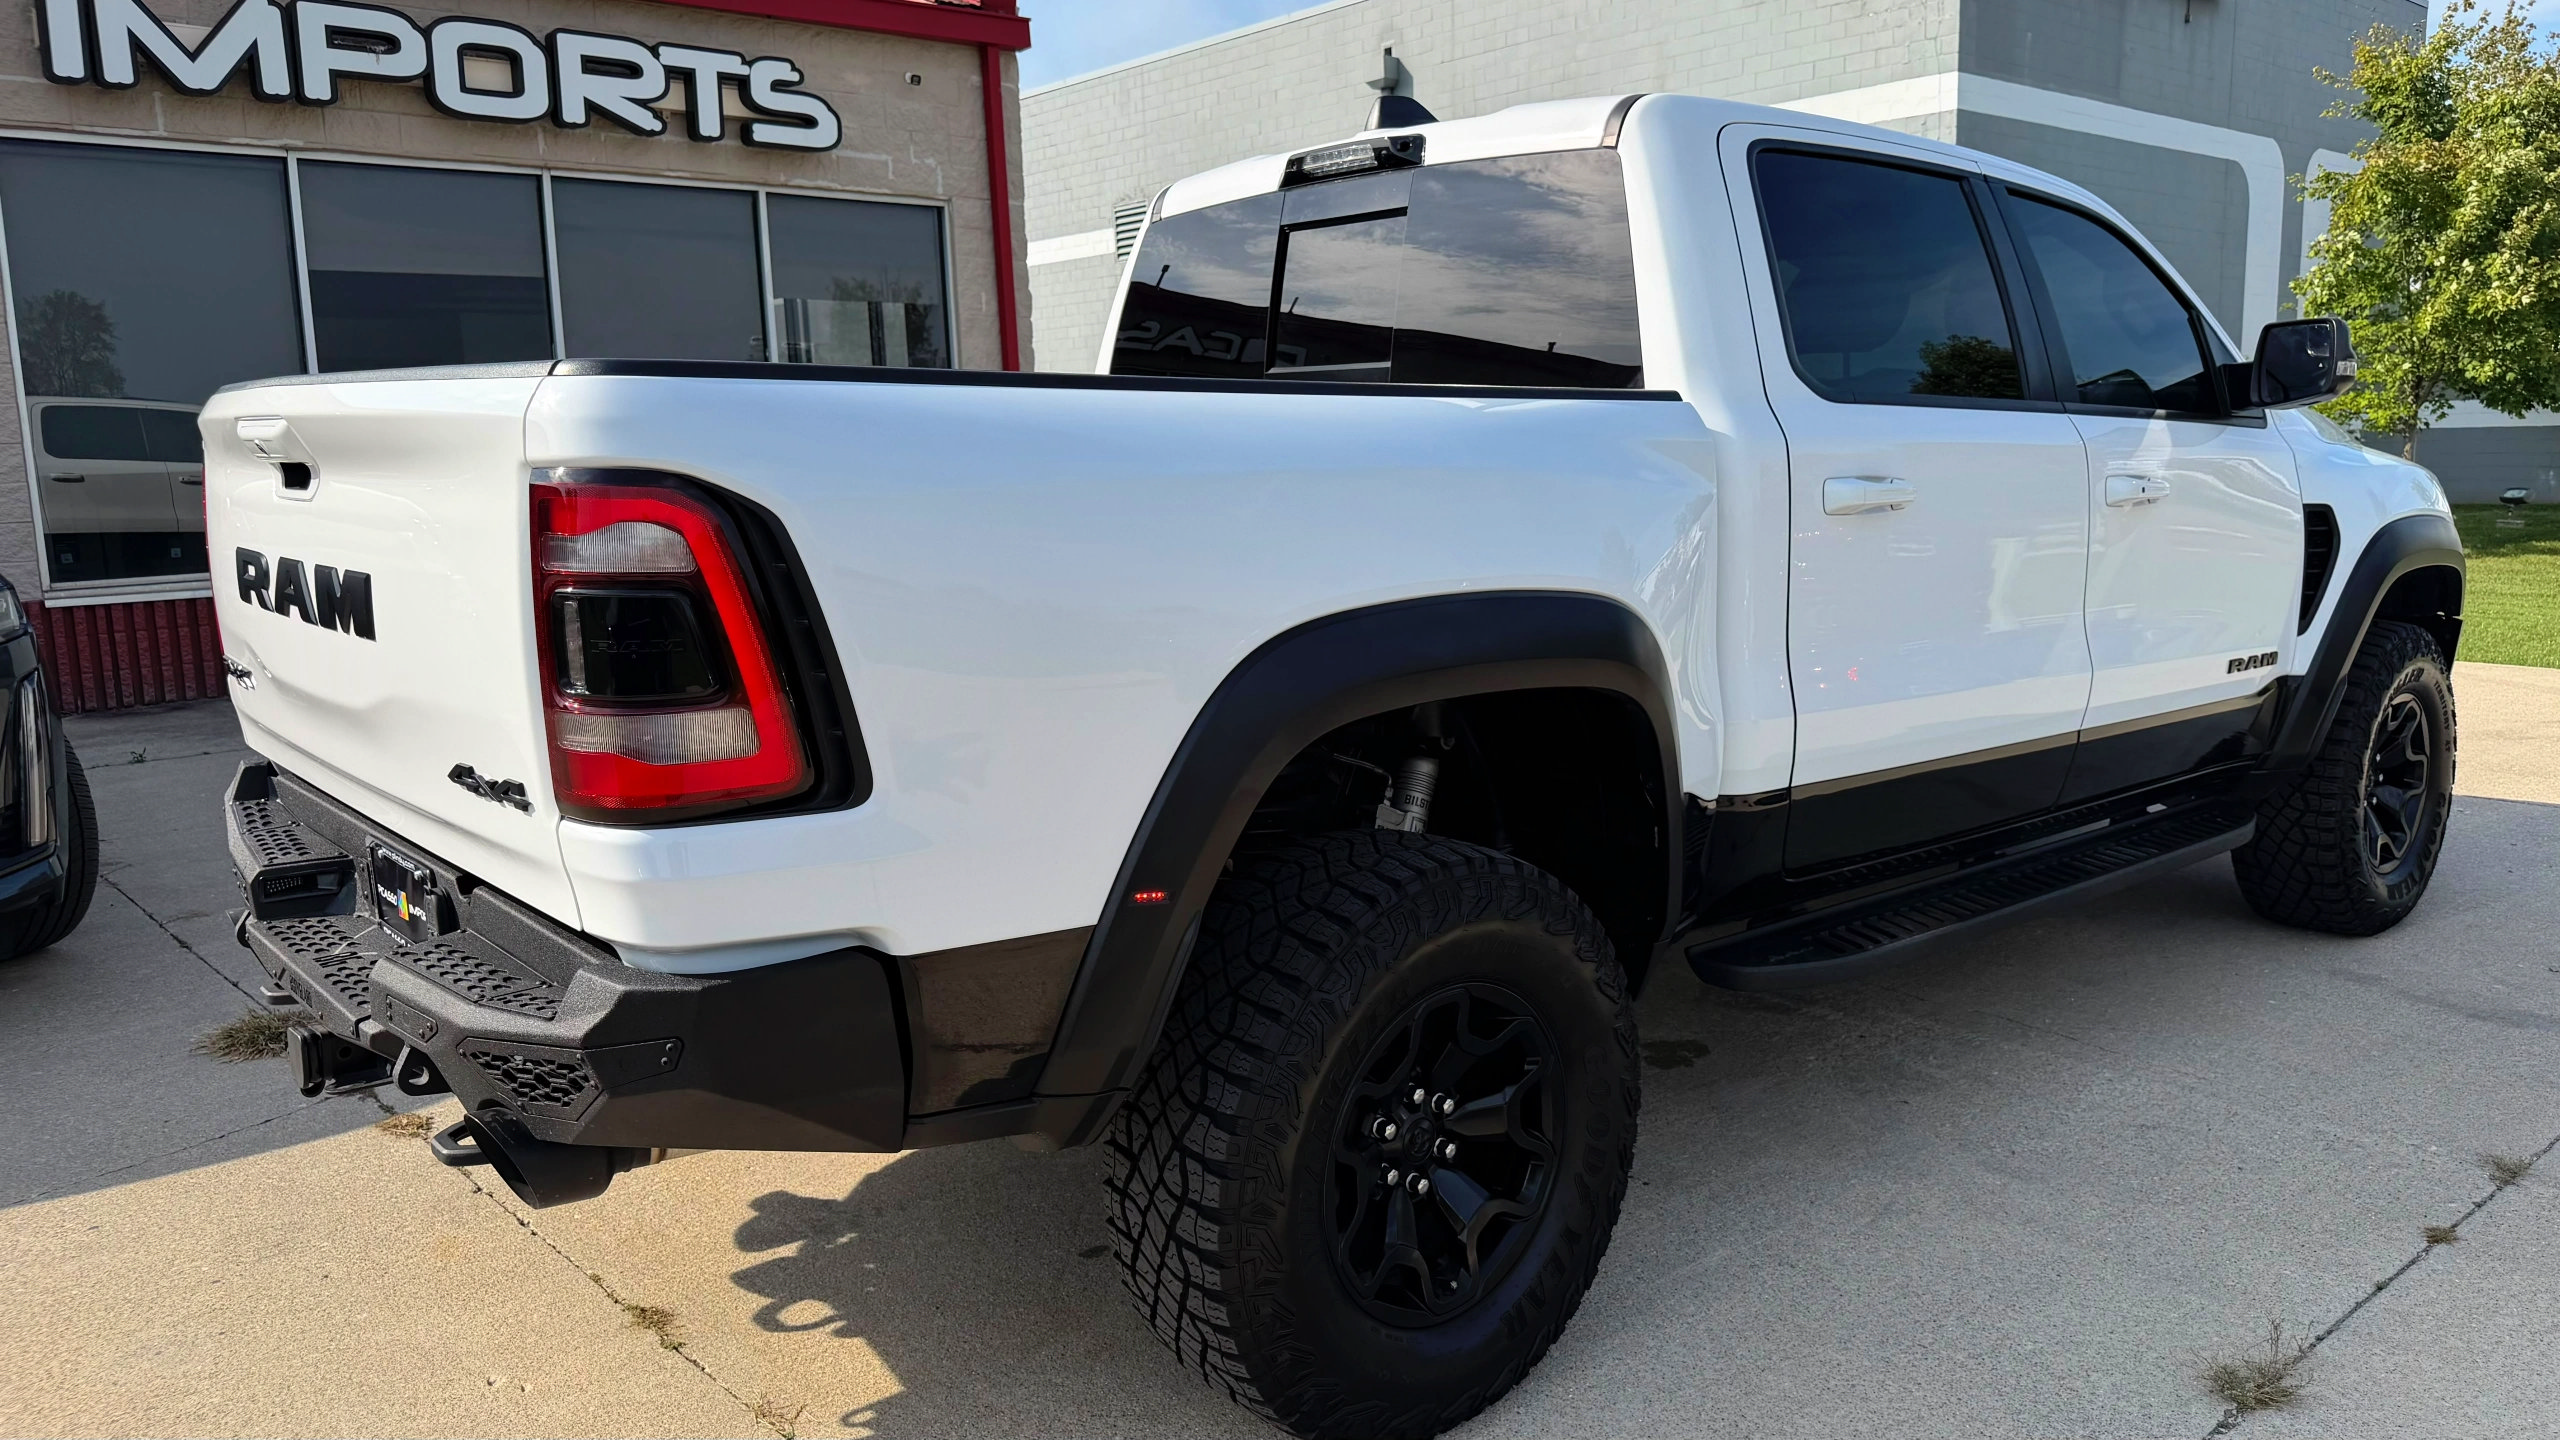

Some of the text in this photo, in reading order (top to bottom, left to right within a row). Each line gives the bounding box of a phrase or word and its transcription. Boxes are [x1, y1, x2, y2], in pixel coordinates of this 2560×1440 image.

[41, 0, 843, 152] IMPORTS
[235, 546, 376, 642] RAM
[2227, 651, 2278, 674] RAM
[2433, 680, 2450, 731] TERRITORY
